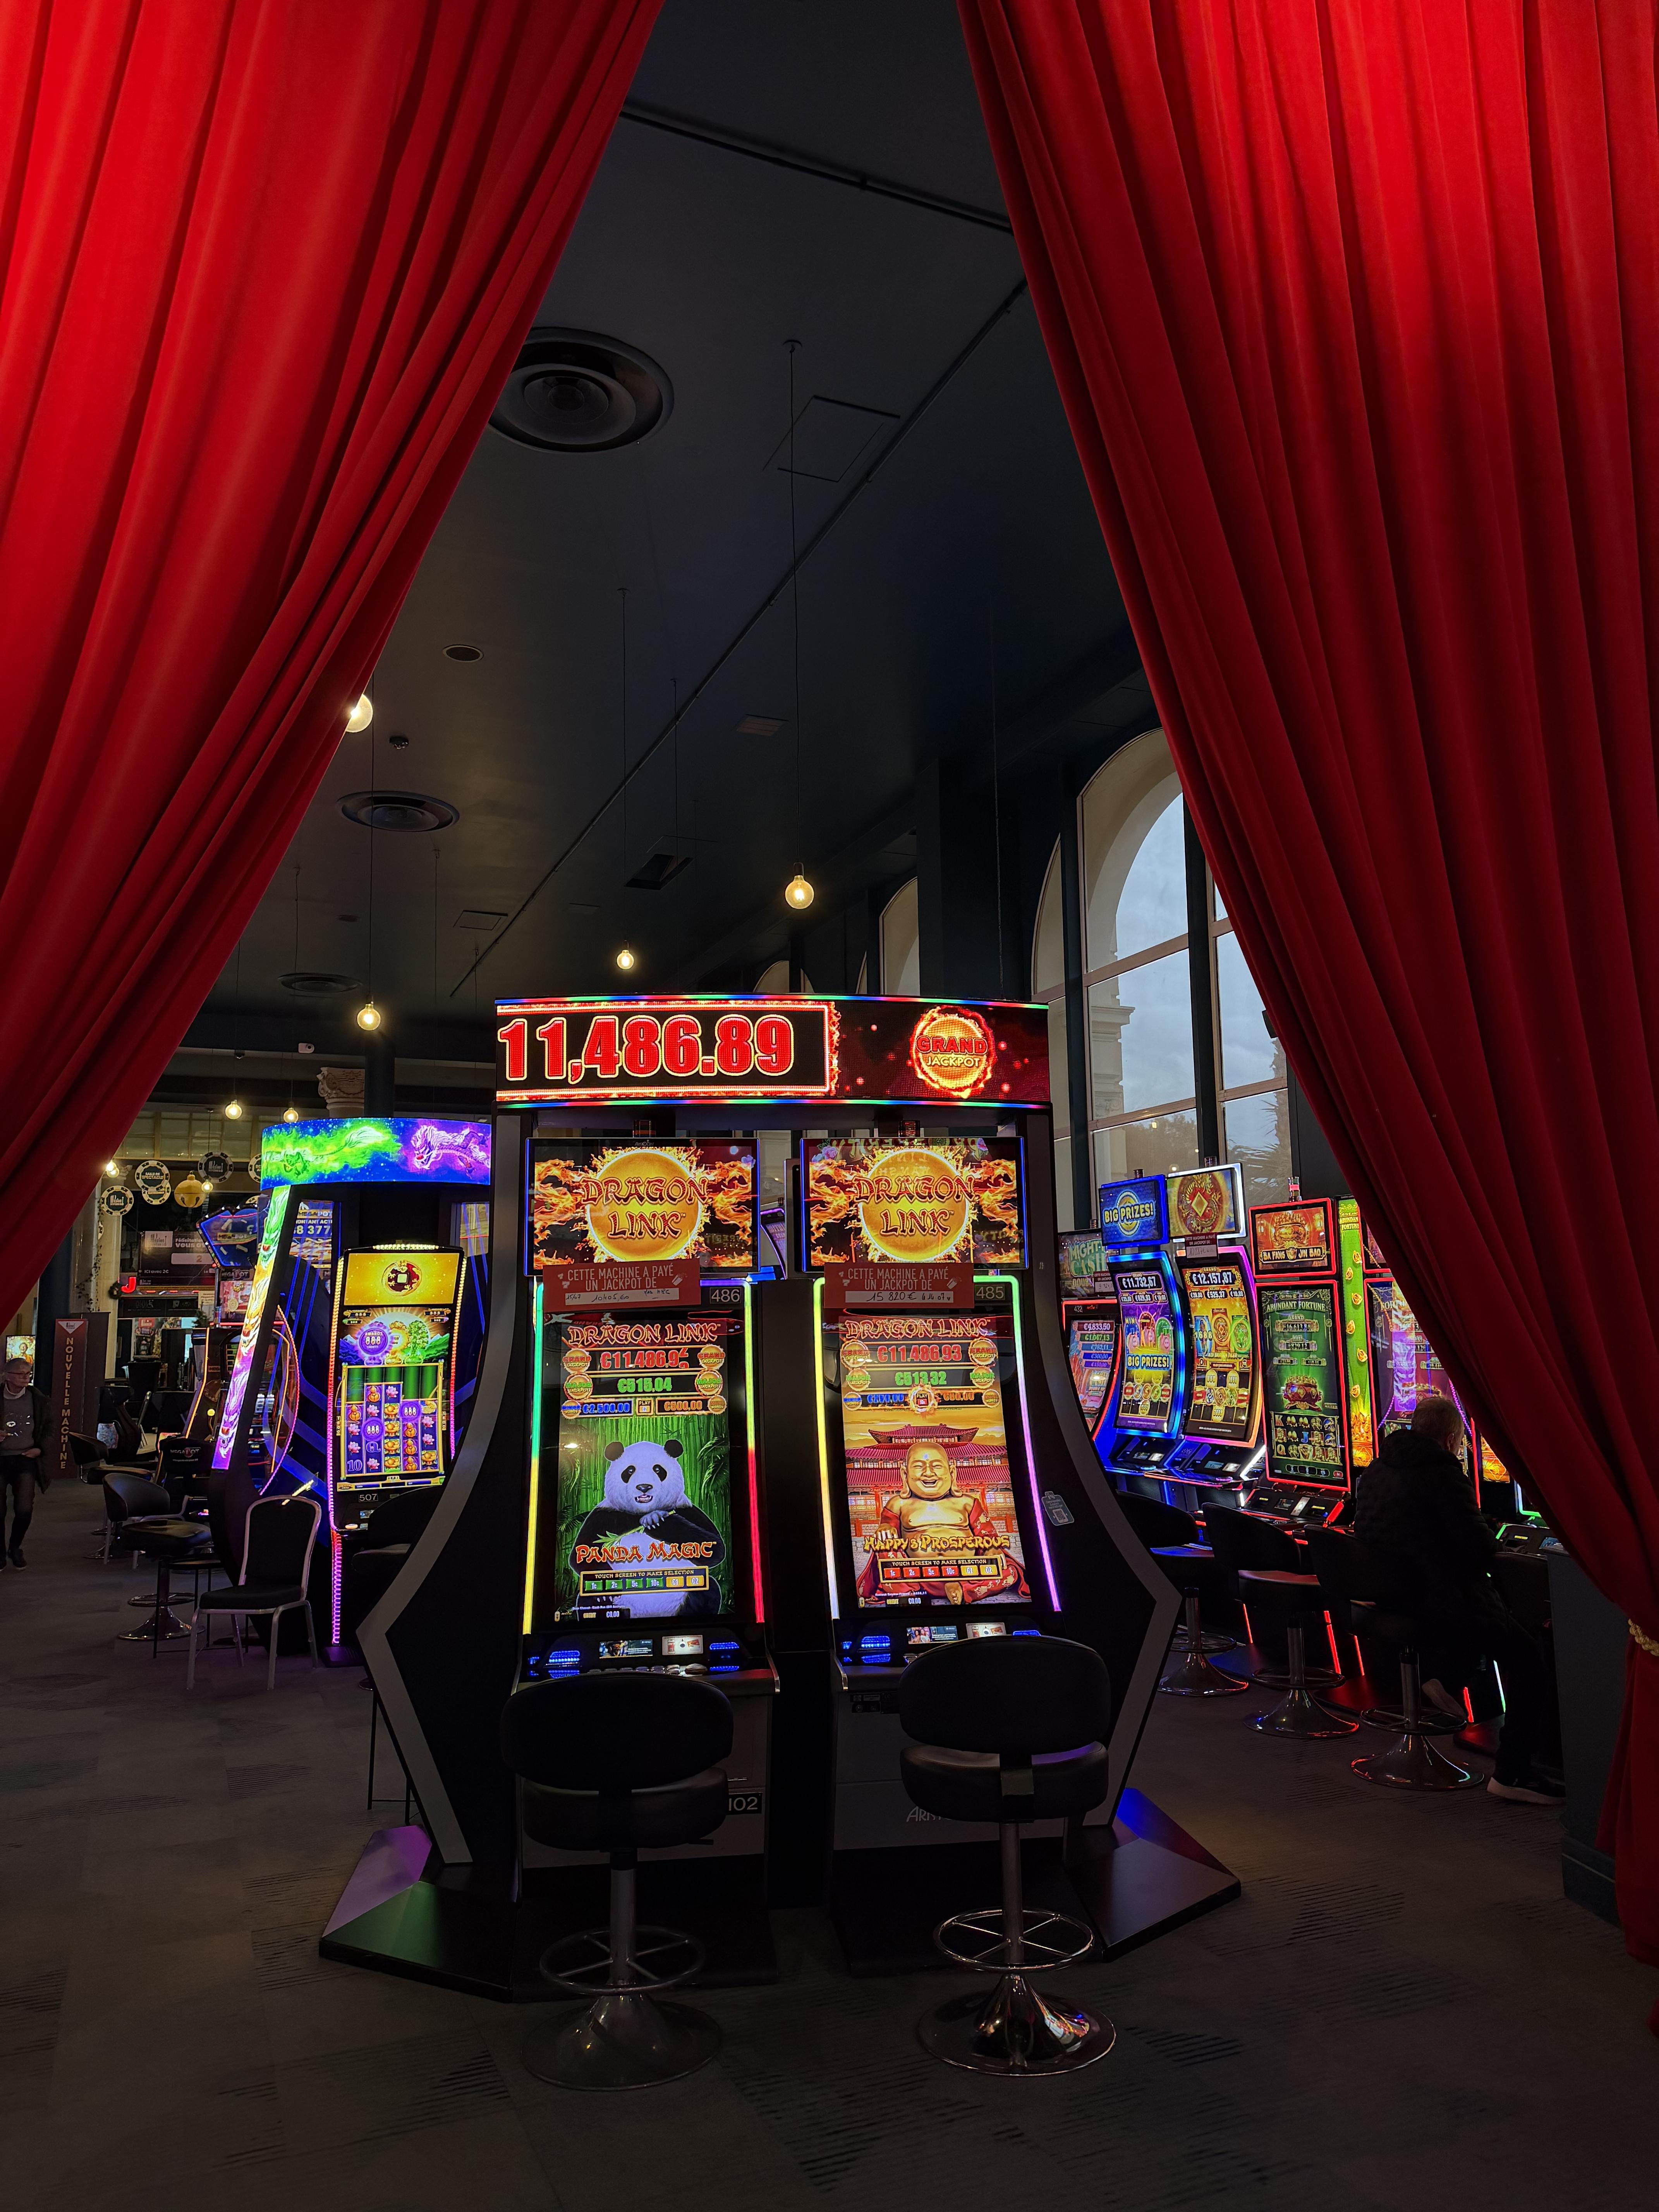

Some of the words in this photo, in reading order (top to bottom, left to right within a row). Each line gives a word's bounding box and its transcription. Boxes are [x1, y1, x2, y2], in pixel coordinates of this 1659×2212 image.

[498, 1014, 795, 1084] 11,486.89
[915, 1035, 988, 1054] GRAND
[927, 1056, 980, 1068] JACKPOT
[580, 1177, 710, 1206] DRAGON
[853, 1175, 979, 1203] DRAGON
[1104, 1209, 1119, 1223] BIG
[1121, 1202, 1154, 1221] PRIZES!
[1263, 1251, 1271, 1261] BA
[1272, 1251, 1285, 1260] FANG
[1298, 1249, 1307, 1258] JIN
[1309, 1248, 1321, 1257] BAO
[568, 1269, 595, 1281] CETTE
[599, 1266, 640, 1279] MACHINE
[643, 1267, 649, 1278] A
[652, 1262, 674, 1277] PAYÉ
[848, 1268, 874, 1279] CETTE
[877, 1268, 916, 1279] MACHINE
[919, 1269, 925, 1279] A
[928, 1266, 948, 1279] PAYÉ
[586, 1279, 598, 1291] UN
[601, 1278, 642, 1290] JACKPOT
[646, 1277, 657, 1288] DE
[865, 1279, 876, 1290] UN
[879, 1279, 918, 1290] JACKPOT
[922, 1279, 932, 1290] DE
[711, 1288, 740, 1303] 486
[976, 1286, 1005, 1300] 485
[1267, 1301, 1297, 1312] ABUNDANT
[1298, 1301, 1326, 1311] FORTUNE
[568, 1324, 661, 1346] DRAGON
[845, 1318, 934, 1340] DRAGON
[1127, 1356, 1140, 1367] BIG
[1141, 1356, 1170, 1368] PRIZES!
[64, 1337, 74, 1405] NOUVELLE
[1275, 1415, 1284, 1426] K
[60, 1409, 70, 1469] MACHINE
[1301, 1431, 1309, 1443] J
[1277, 1444, 1286, 1455] Q
[347, 1459, 362, 1472] 10
[864, 1537, 908, 1551] HAPPY
[920, 1534, 1010, 1550] PROSPEROUS
[575, 1545, 643, 1564] PANDA
